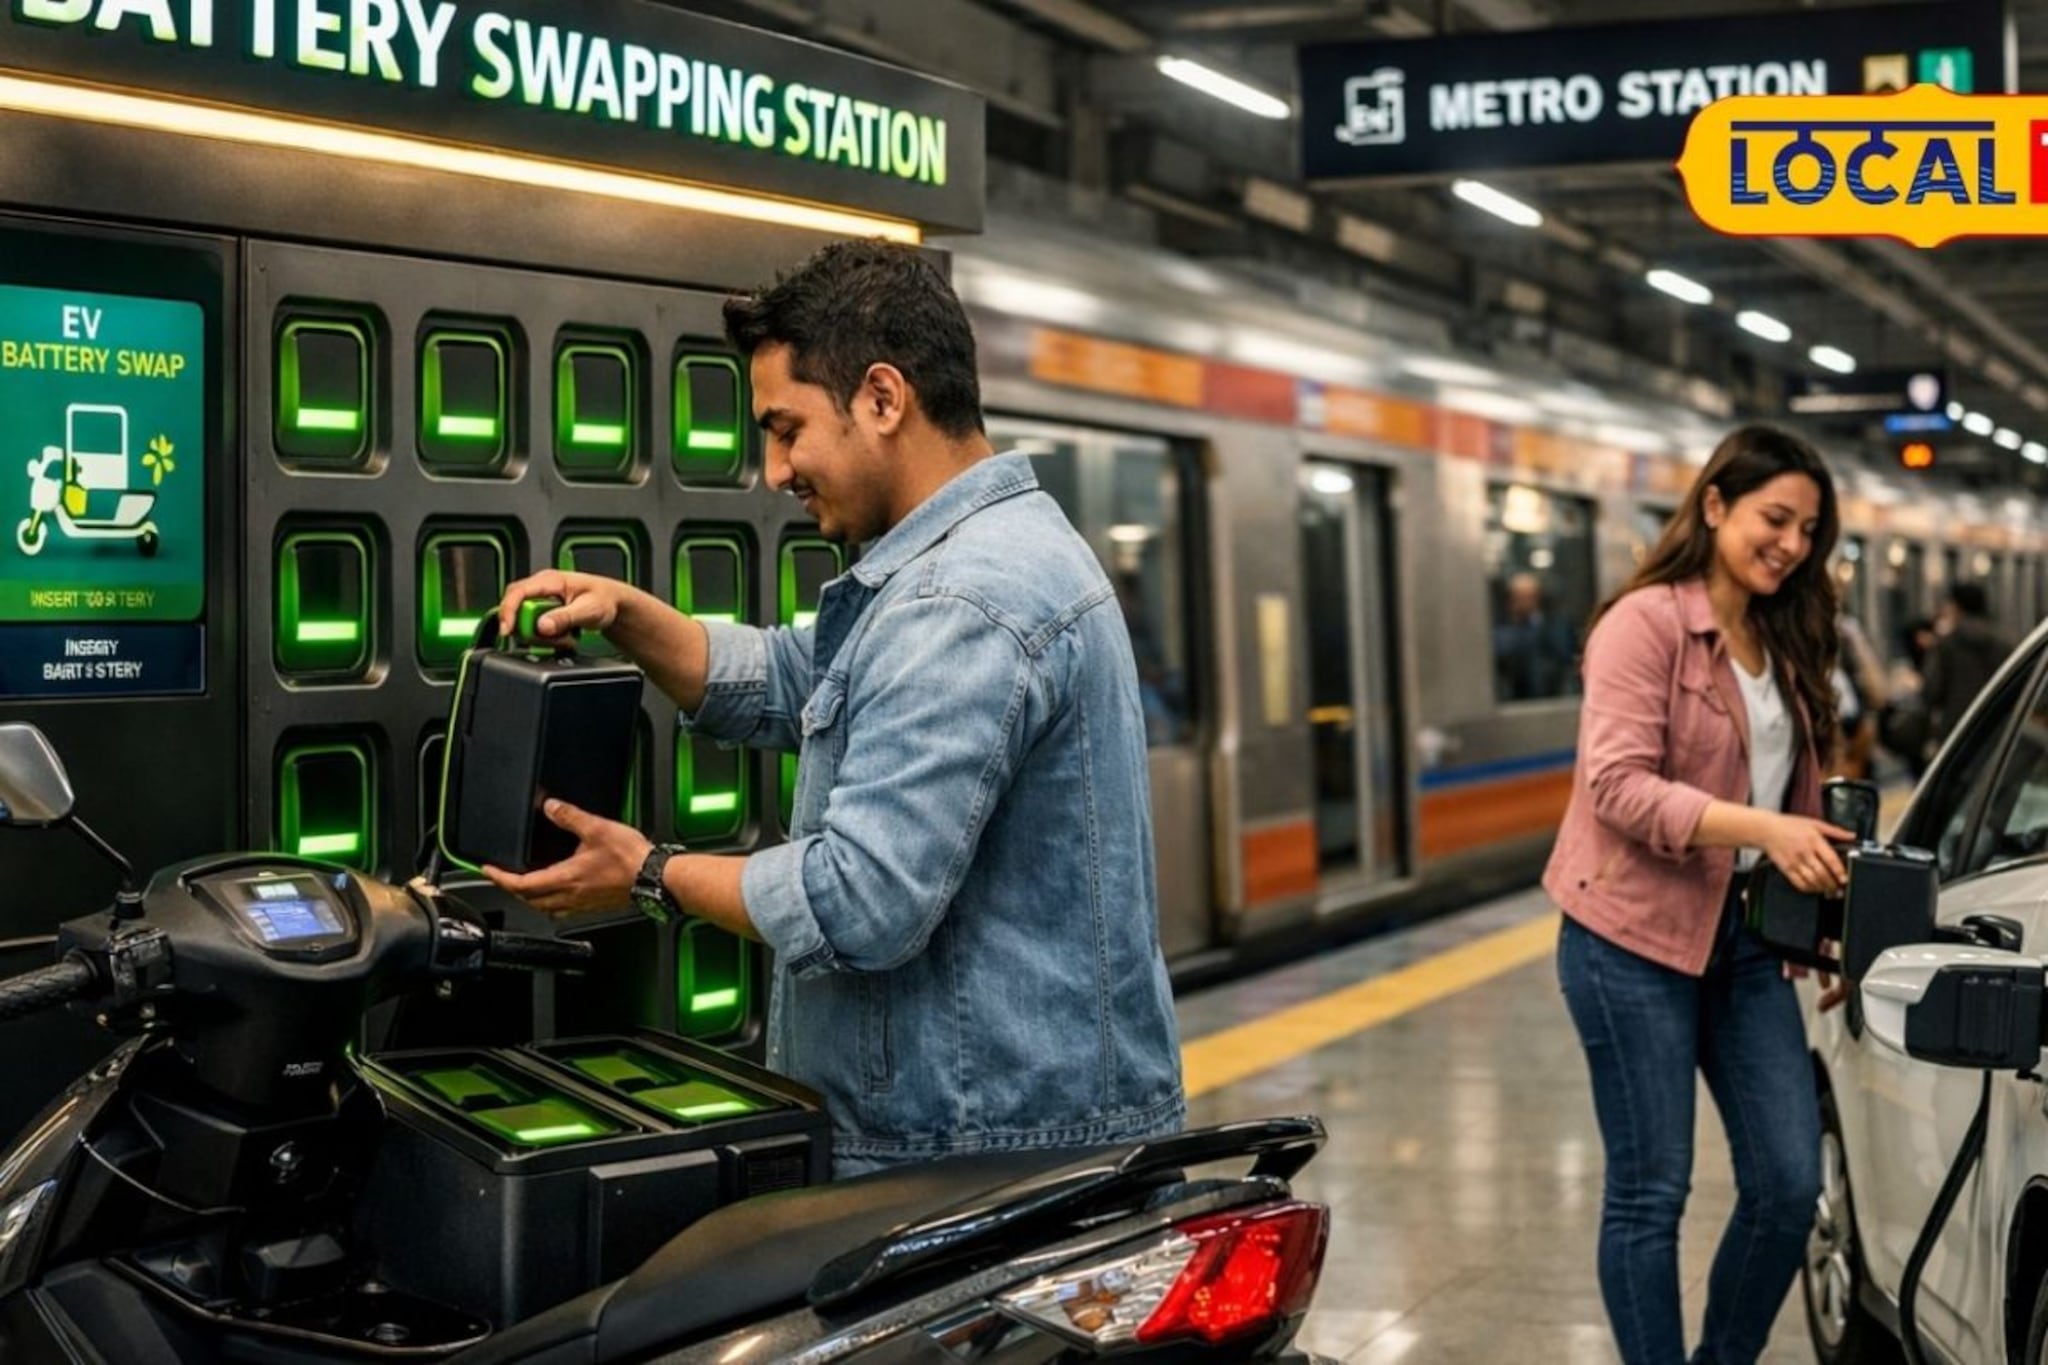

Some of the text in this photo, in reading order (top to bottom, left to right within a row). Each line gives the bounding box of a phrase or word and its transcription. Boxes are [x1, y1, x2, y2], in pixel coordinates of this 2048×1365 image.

[22, 0, 947, 186] TERY SWAPPING STATION
[1428, 59, 1827, 131] METRO STATION
[62, 304, 103, 340] EV
[1, 340, 186, 379] BATTERY SWAP
